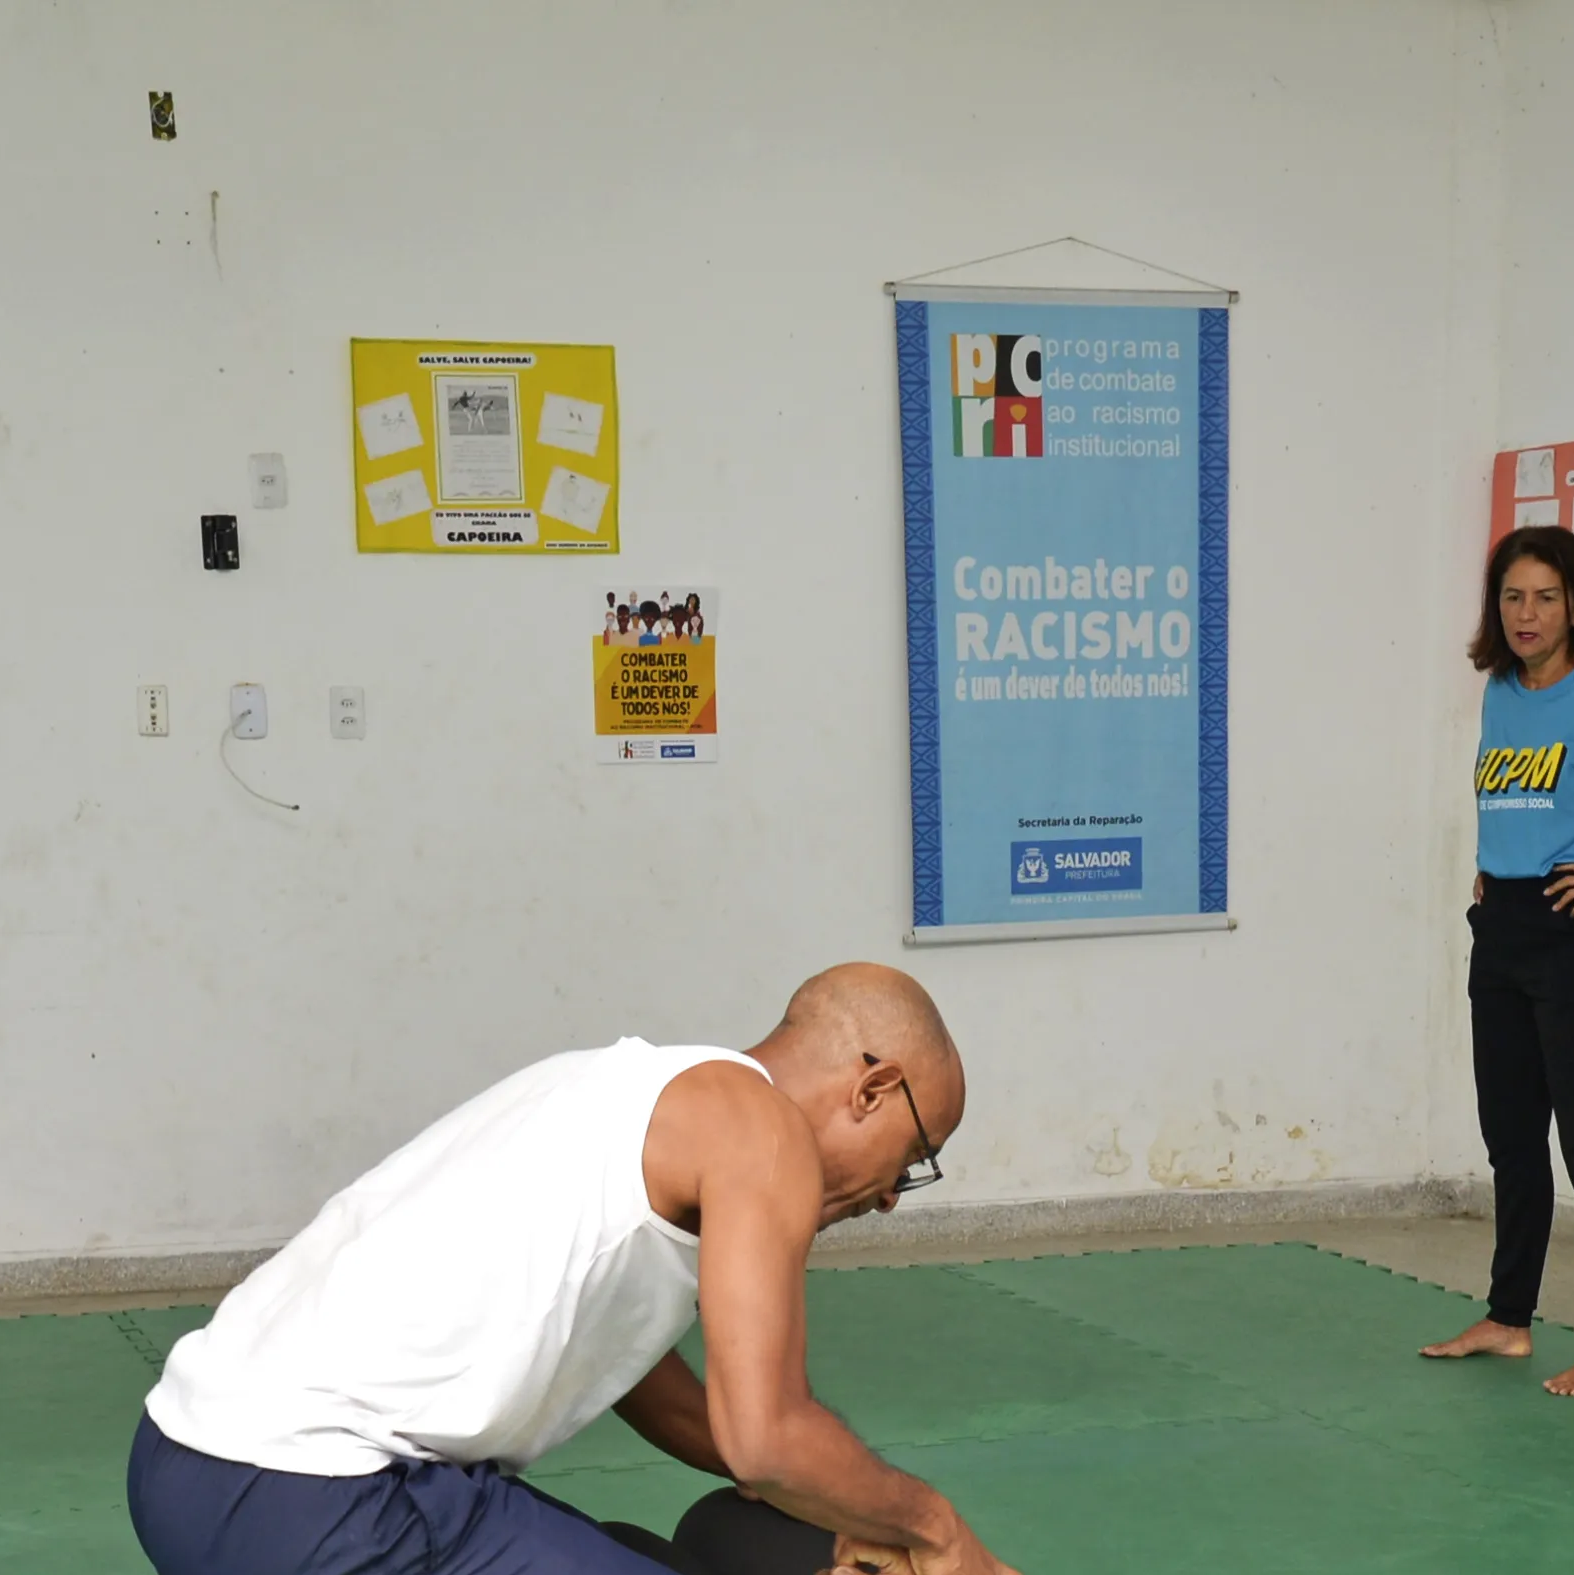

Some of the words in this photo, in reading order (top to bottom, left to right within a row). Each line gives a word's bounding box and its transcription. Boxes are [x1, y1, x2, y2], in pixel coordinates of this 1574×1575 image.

[452, 356, 481, 364] SALVE
[1046, 338, 1181, 363] programa
[1046, 367, 1075, 391] de
[1079, 370, 1176, 392] combate
[1047, 403, 1075, 424] ao
[1092, 403, 1181, 425] racismo
[1047, 434, 1181, 458] institucional
[447, 531, 524, 543] CAPOEIRA
[953, 555, 1154, 601] Combater
[1166, 566, 1189, 600] o
[954, 610, 1191, 662] RACISMO
[621, 653, 687, 666] COMBATER
[621, 669, 630, 683] O
[633, 669, 688, 683] RACISMO
[955, 667, 967, 701] é
[971, 675, 1002, 700] um
[1005, 665, 1060, 700] dever
[1063, 664, 1086, 698] de
[1090, 664, 1143, 698] todos
[1147, 662, 1189, 697] nós!
[611, 681, 619, 700] É
[621, 685, 640, 700] UM
[641, 685, 681, 699] DEVER
[682, 685, 699, 699] DE
[621, 701, 660, 716] TODOS
[662, 698, 691, 715] NÓS!
[1528, 797, 1555, 809] SOCIAL
[1018, 816, 1071, 828] Secretaria
[1073, 816, 1086, 826] da
[1089, 814, 1143, 827] Reparação
[1054, 850, 1131, 869] SALVADOR
[1065, 869, 1120, 880] PREFEITURA
